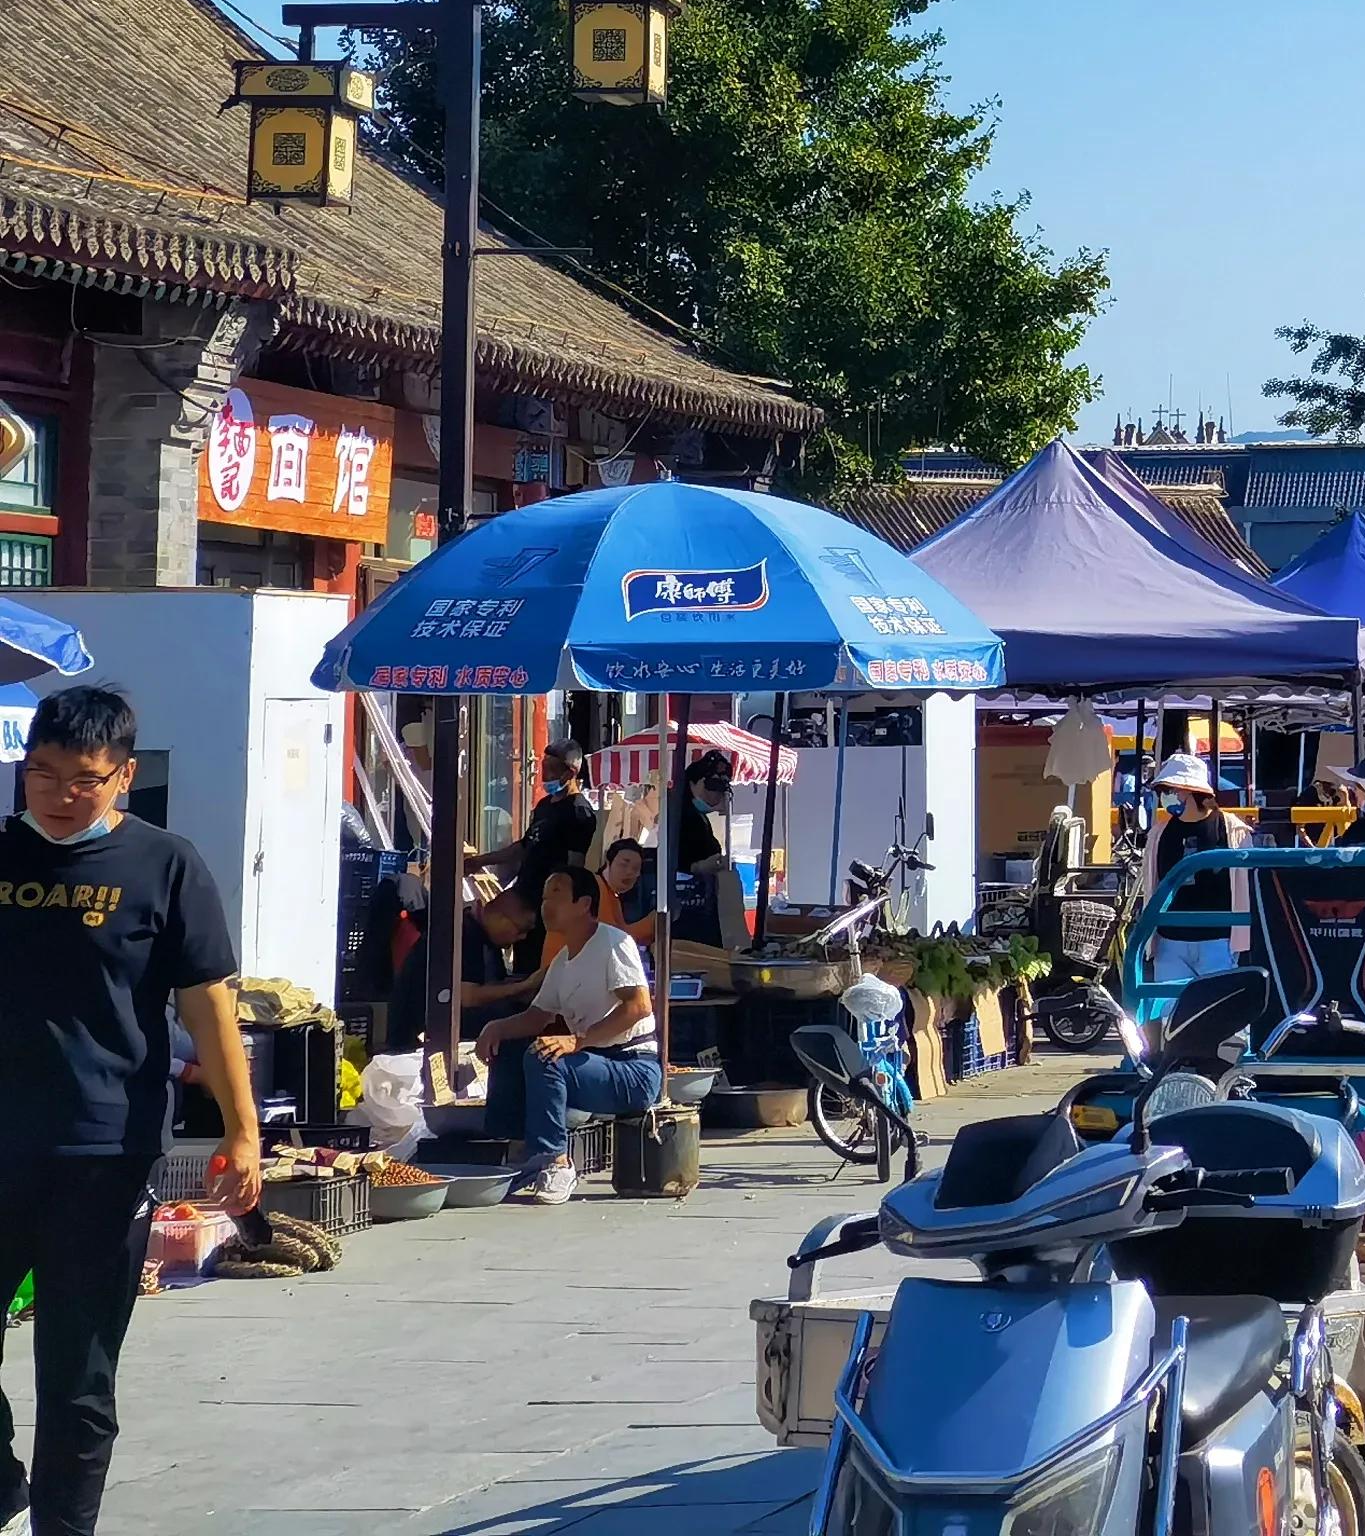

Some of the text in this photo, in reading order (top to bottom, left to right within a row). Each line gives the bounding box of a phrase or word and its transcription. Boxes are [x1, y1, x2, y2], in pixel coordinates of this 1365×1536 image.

[267, 414, 378, 516] 面馆
[425, 599, 525, 617] 国家专利
[410, 619, 510, 639] 技术保证
[605, 657, 808, 681] 饮水安心 生活更美好
